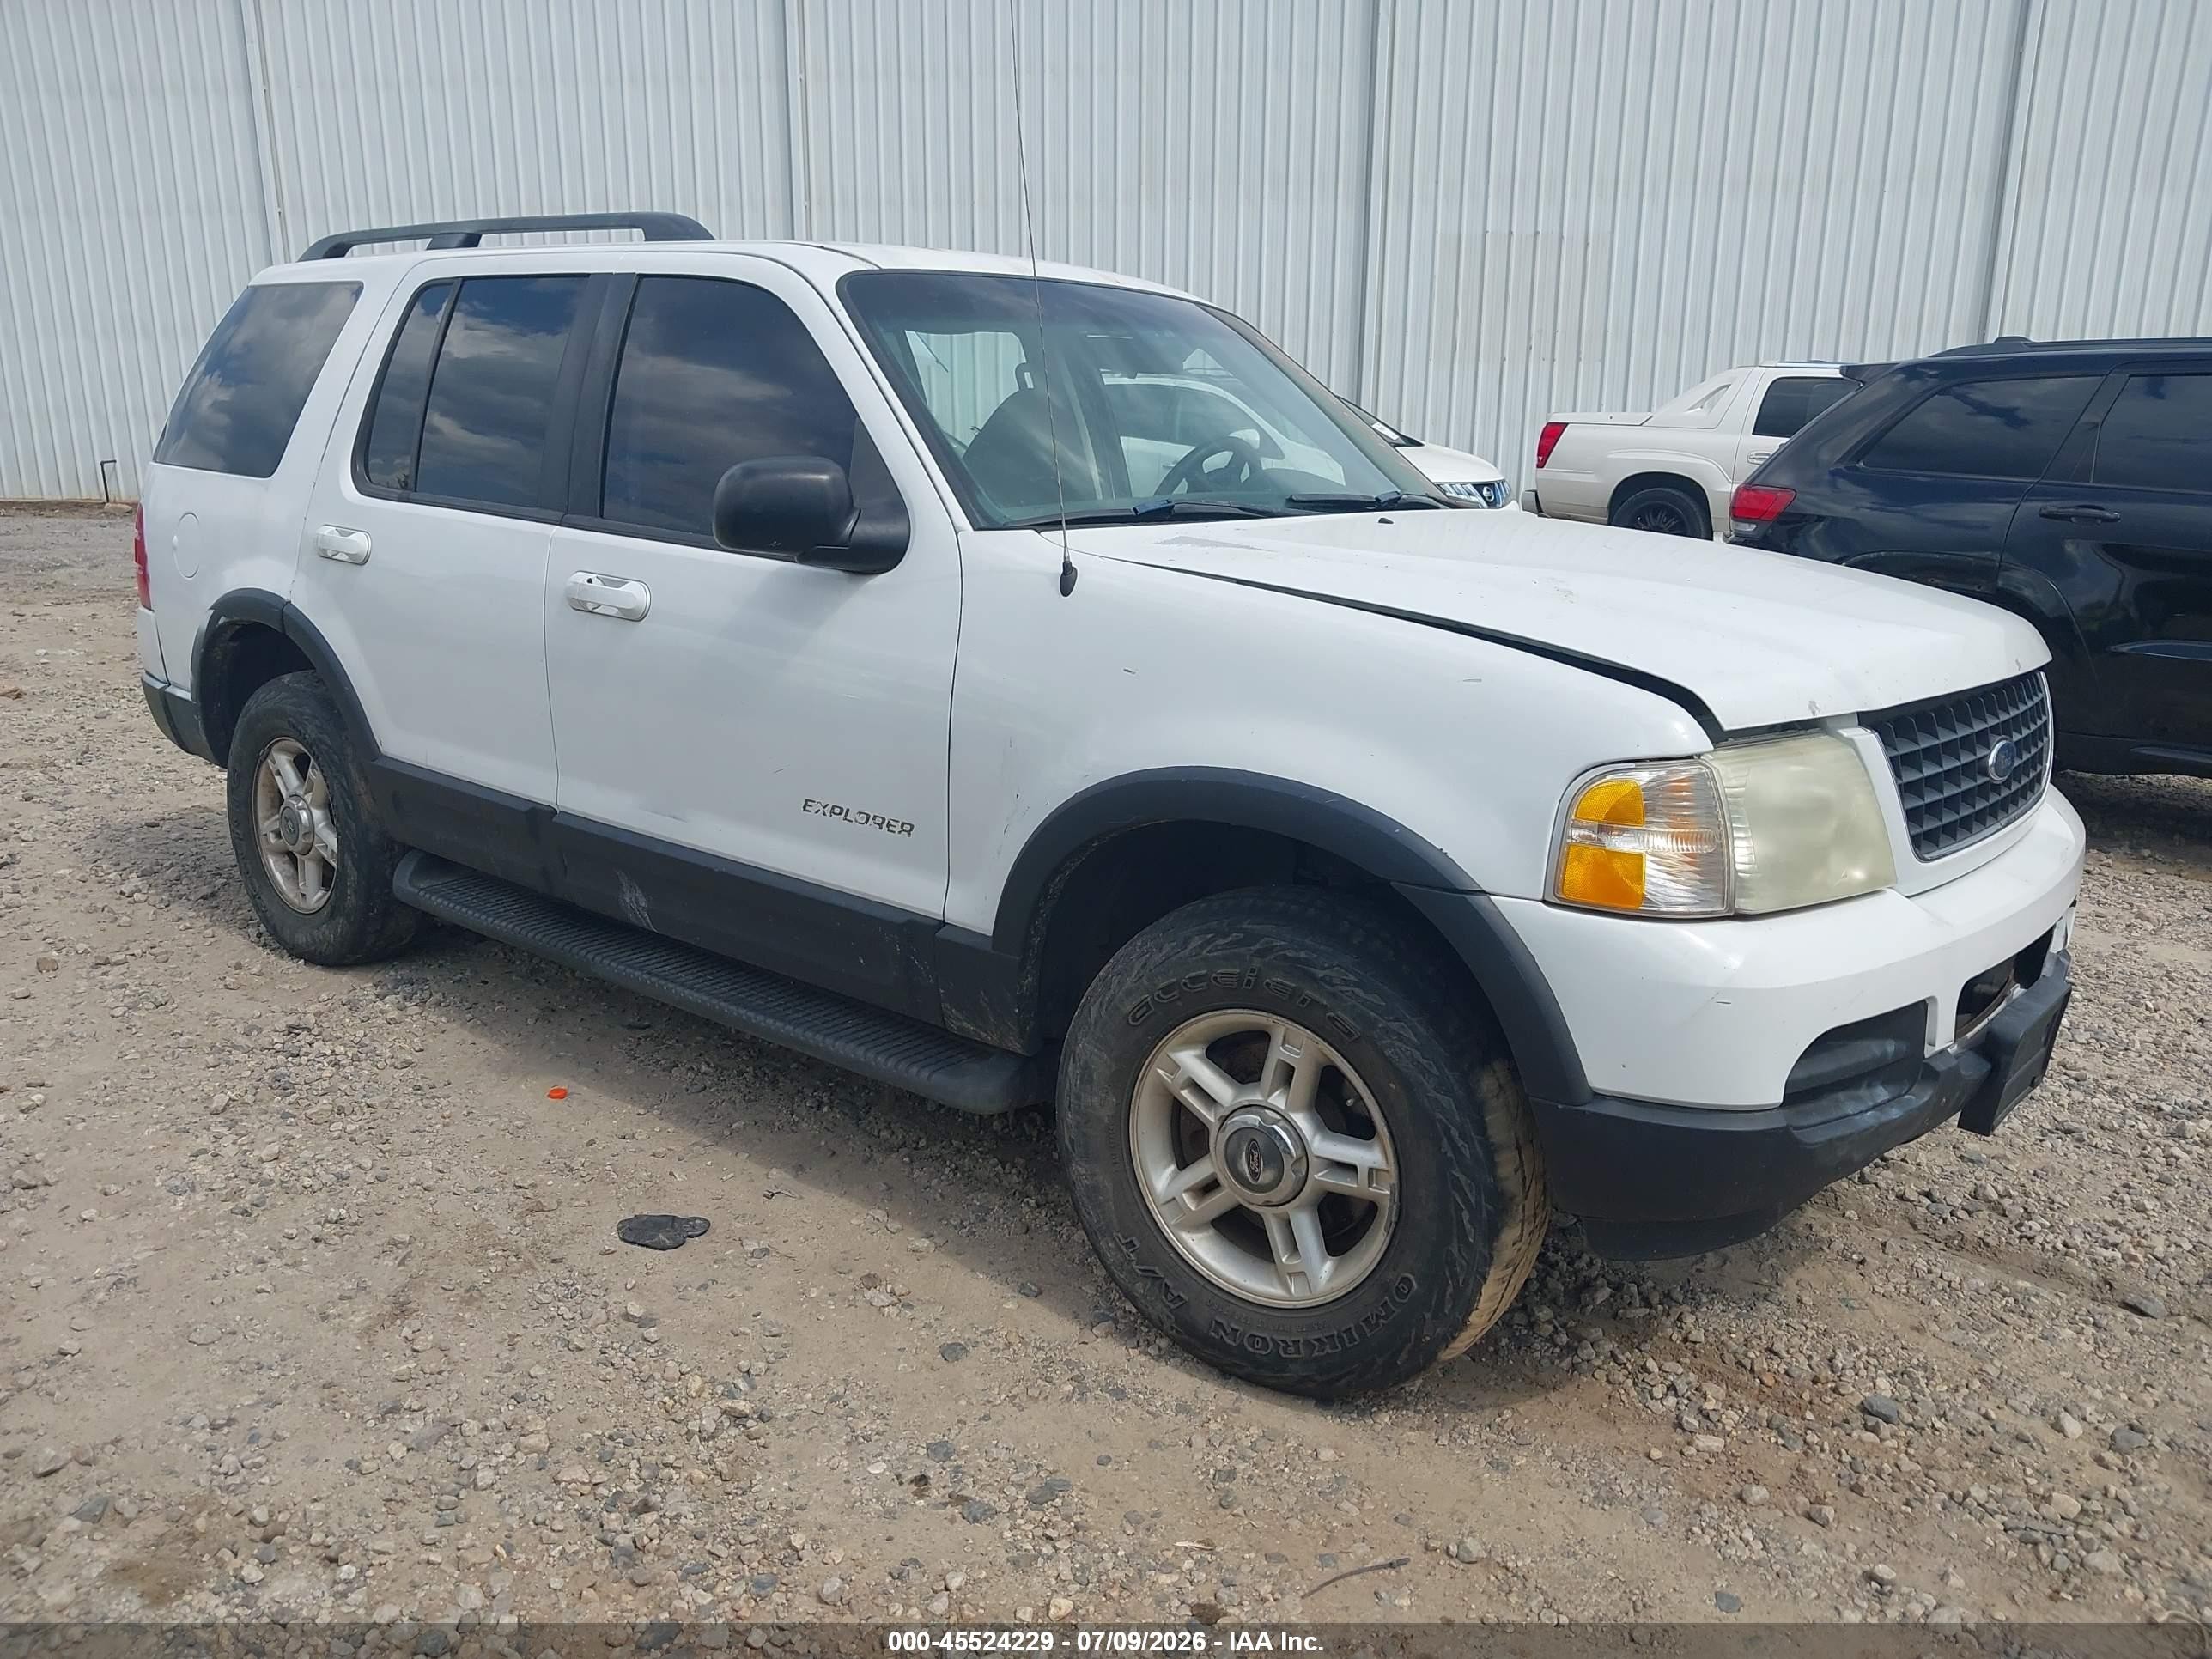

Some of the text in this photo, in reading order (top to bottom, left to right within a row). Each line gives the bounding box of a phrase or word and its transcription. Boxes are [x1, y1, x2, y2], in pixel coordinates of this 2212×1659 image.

[802, 798, 915, 838] EXPLORER
[1113, 1230, 1189, 1311] A/T
[1208, 1273, 1419, 1358] OMIKRON
